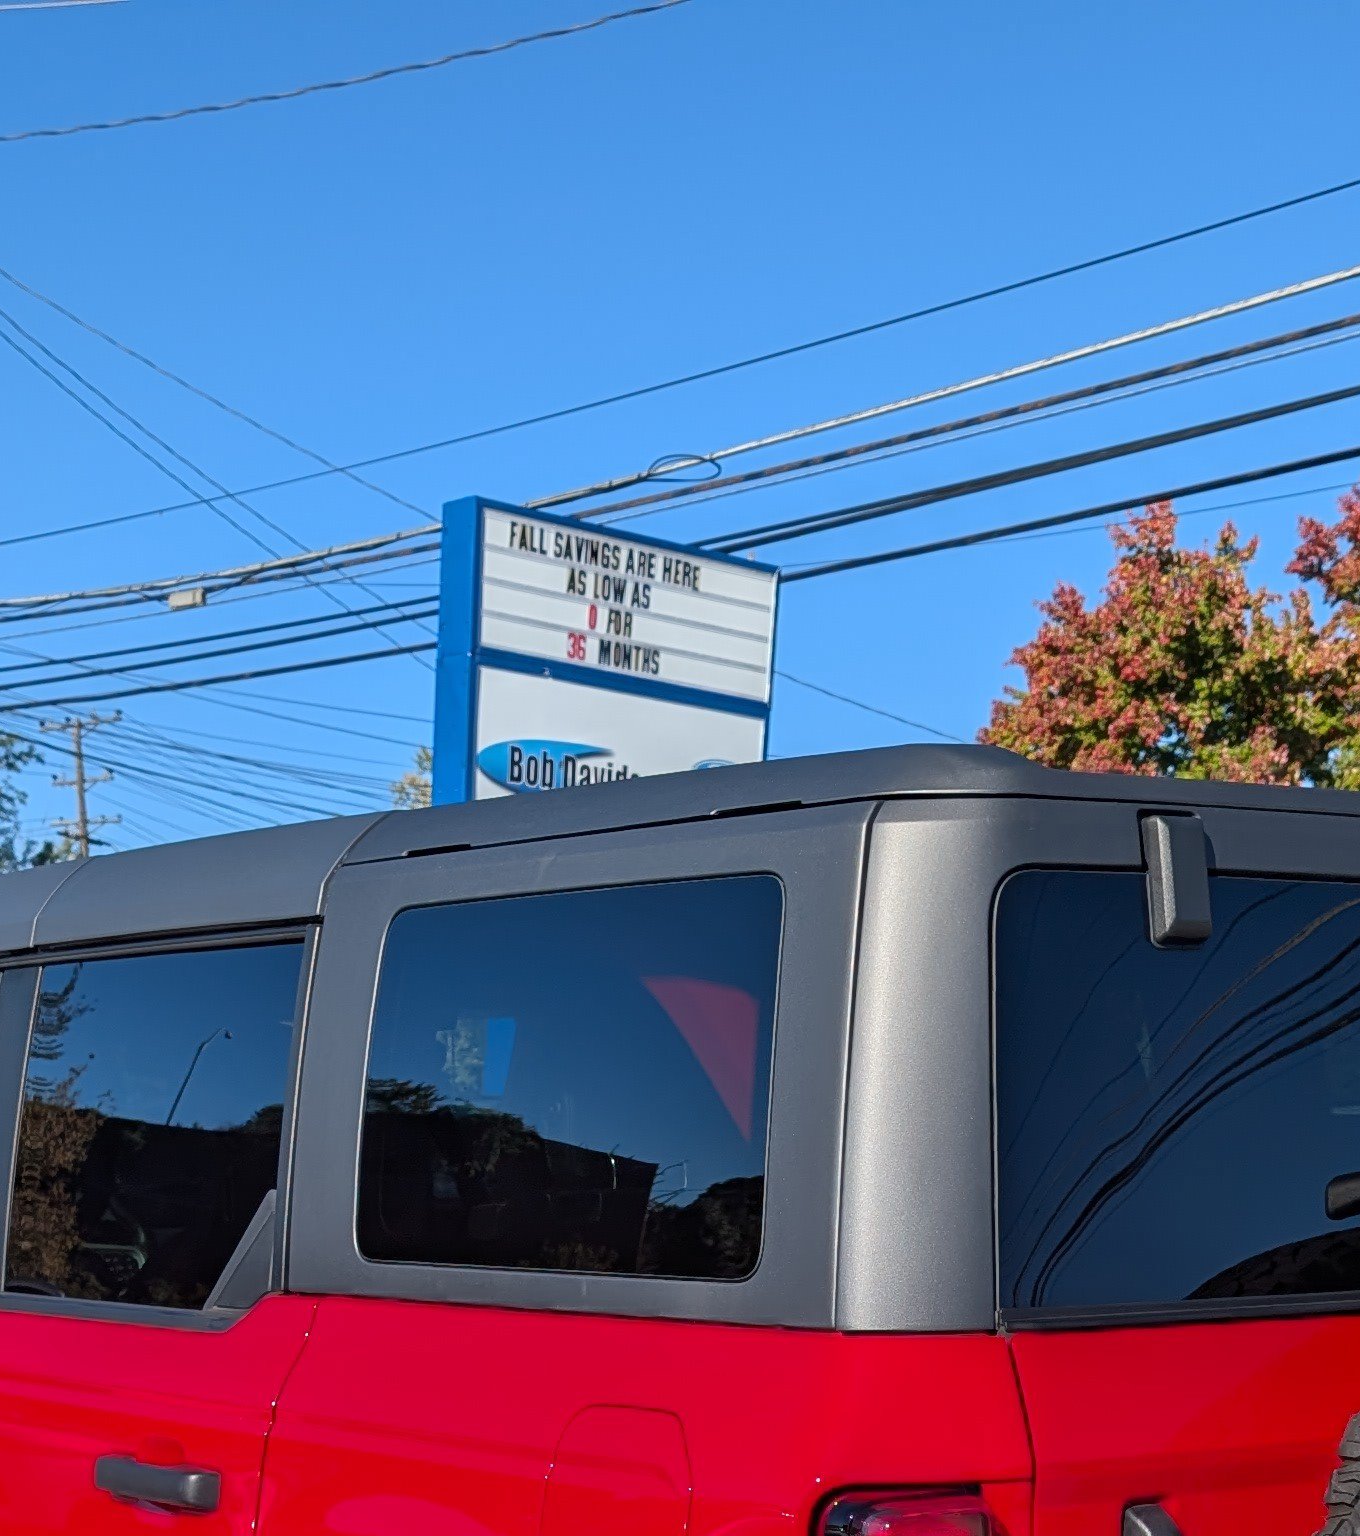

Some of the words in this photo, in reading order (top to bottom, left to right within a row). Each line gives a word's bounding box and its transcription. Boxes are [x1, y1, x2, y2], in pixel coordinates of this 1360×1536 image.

[509, 521, 547, 555] FALL
[554, 532, 621, 570] SAVINGS
[626, 548, 656, 579] ARE
[662, 555, 700, 591] HERE
[567, 568, 586, 596] AS
[594, 571, 626, 604] LOW
[631, 581, 651, 609] AS
[588, 604, 598, 630] 0
[606, 609, 633, 638] FOR
[567, 632, 586, 661] 36
[598, 639, 660, 675] MONTHS
[509, 746, 554, 788] Bob
[564, 754, 638, 787] Davi
